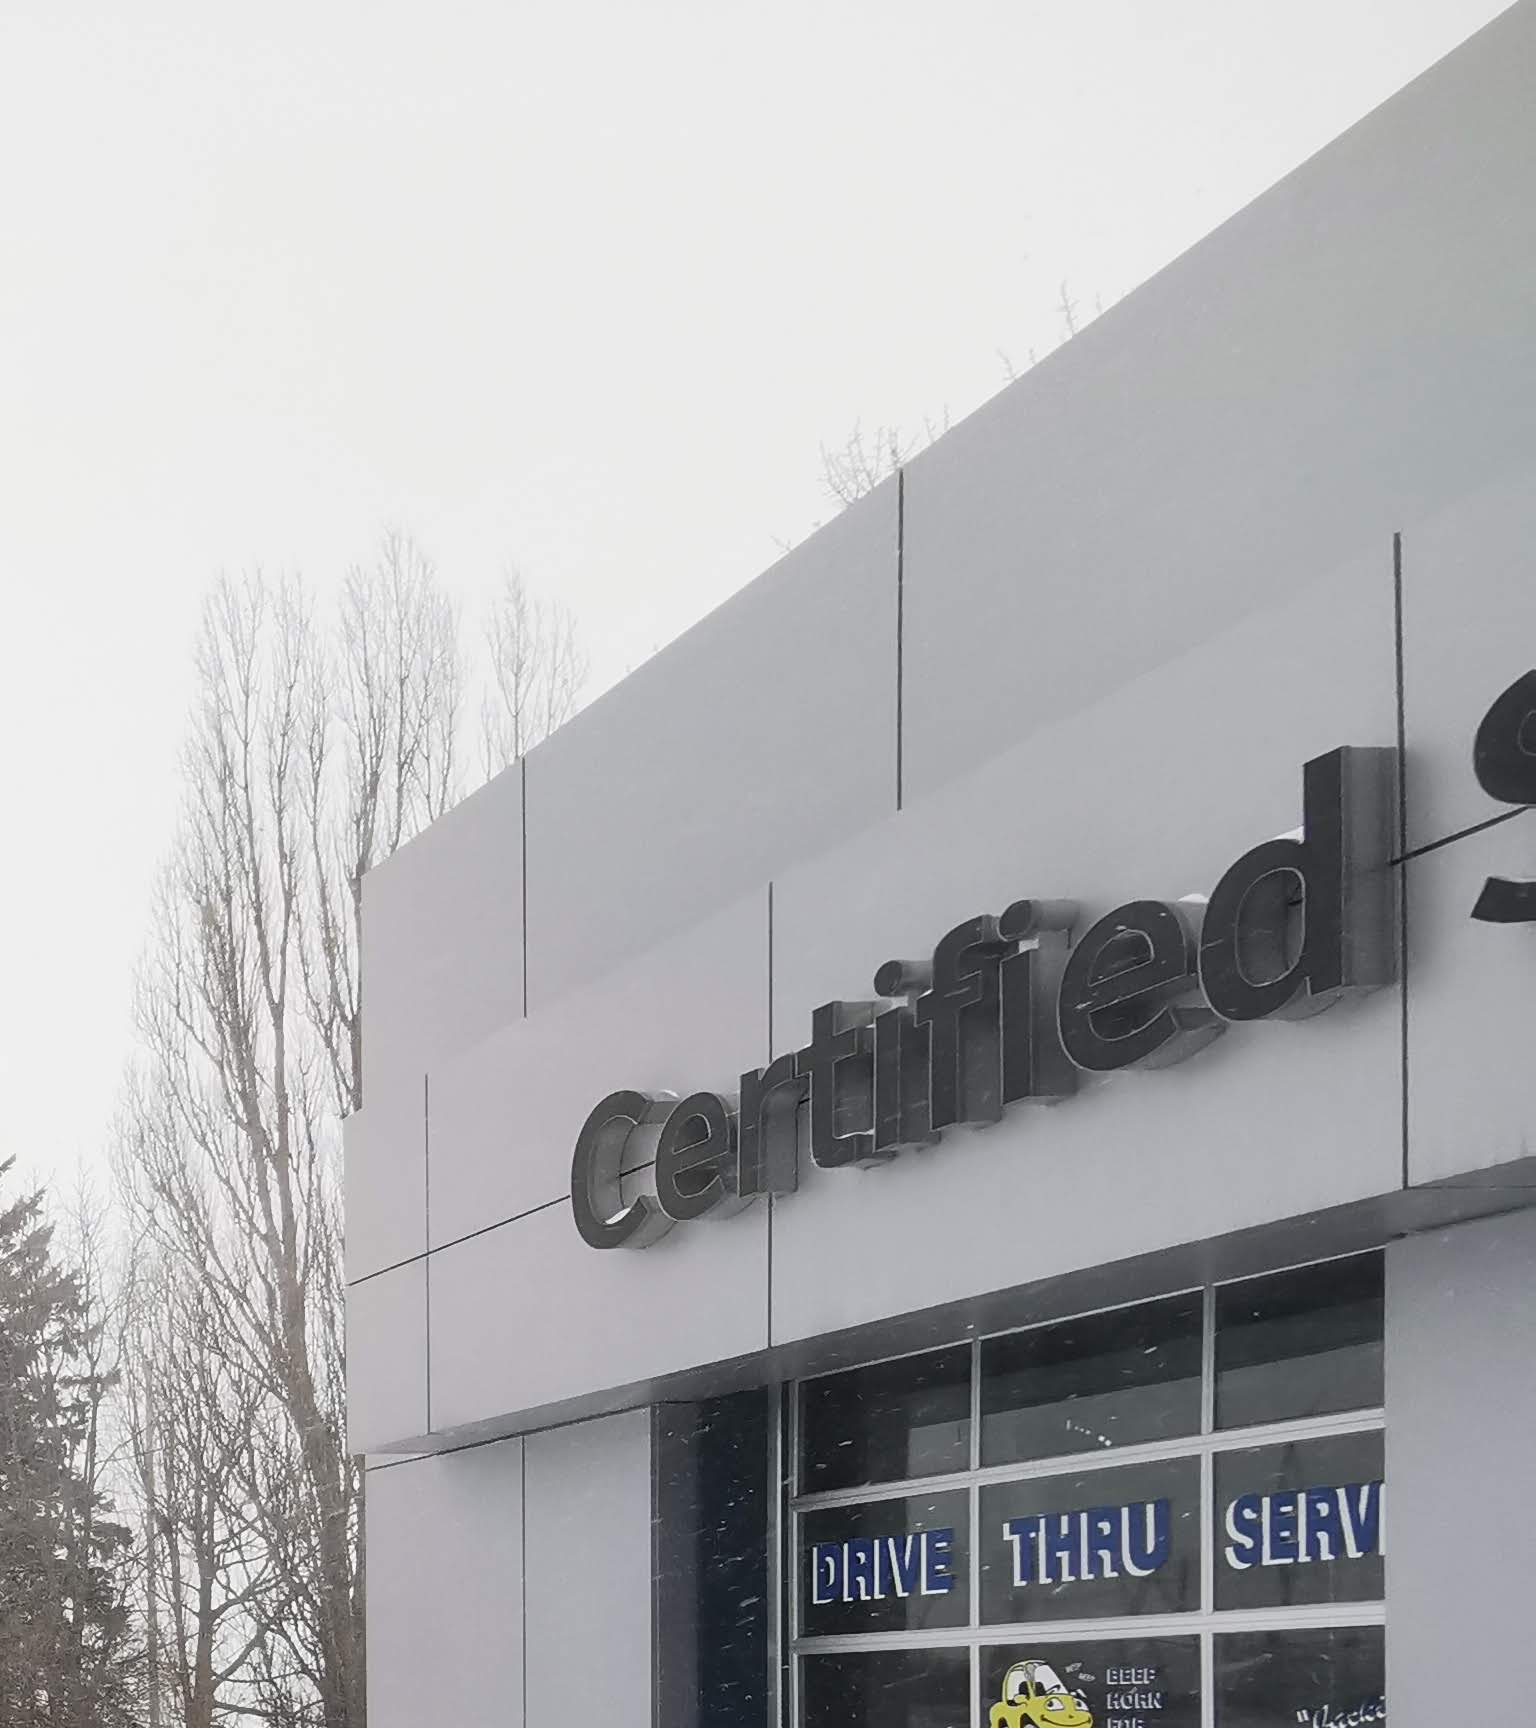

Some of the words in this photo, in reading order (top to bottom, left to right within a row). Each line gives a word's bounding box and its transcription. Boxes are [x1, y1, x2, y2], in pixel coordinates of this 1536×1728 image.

[571, 745, 1397, 1250] Certified
[812, 1527, 954, 1604] DRIVE
[1003, 1498, 1169, 1587] THRU
[1106, 1665, 1157, 1685] BEEP
[1106, 1690, 1163, 1710] HORN
